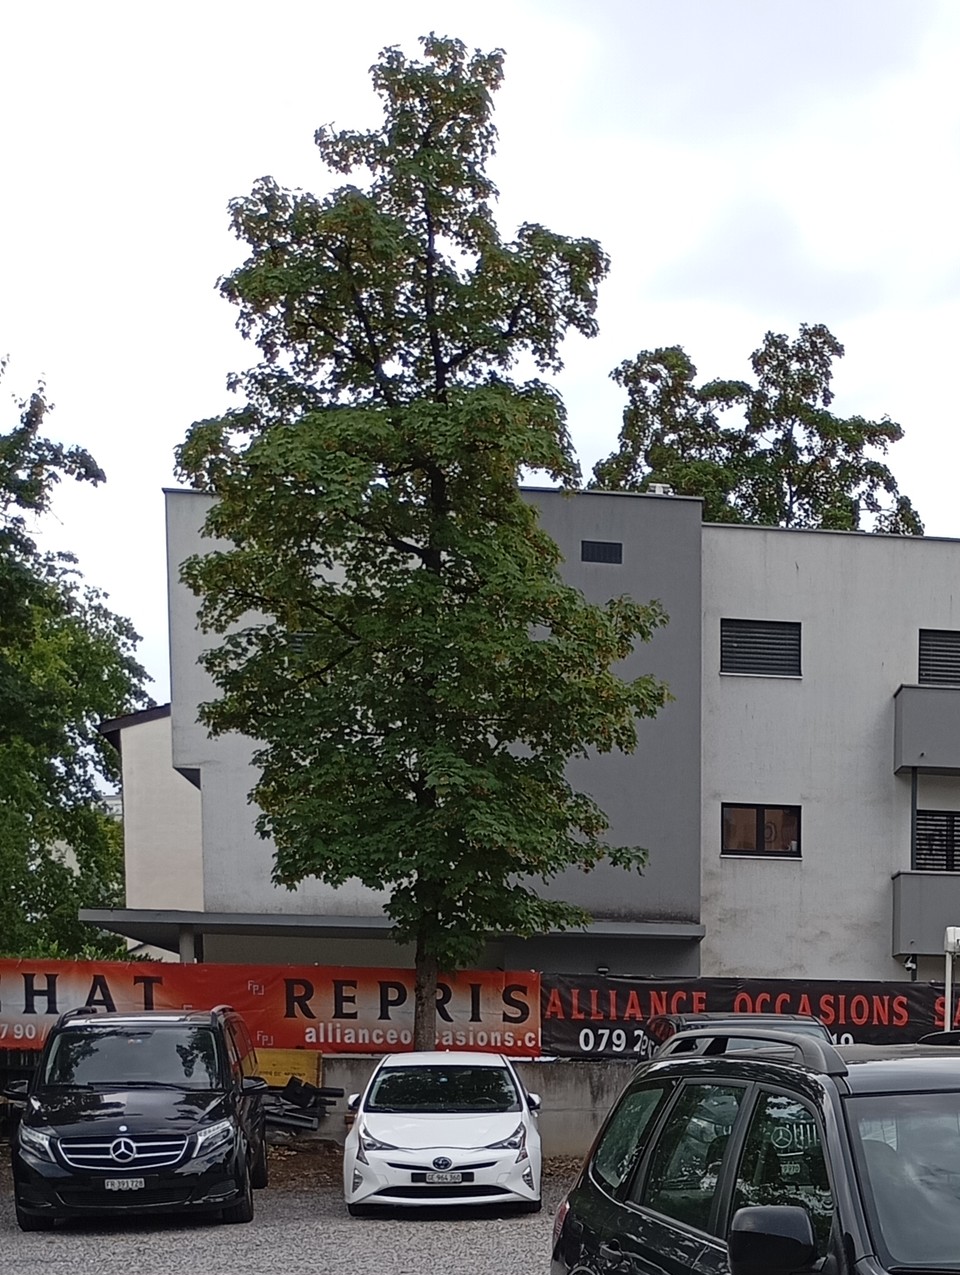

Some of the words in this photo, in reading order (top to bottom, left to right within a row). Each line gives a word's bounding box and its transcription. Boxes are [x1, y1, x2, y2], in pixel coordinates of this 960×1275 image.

[0, 972, 163, 1014] HAT
[283, 978, 530, 1024] REPRIS
[545, 988, 707, 1020] ALLIANCE
[734, 992, 909, 1026] OCCASIONS
[305, 1022, 541, 1047] allianceoasions.c
[579, 1028, 626, 1052] 079
